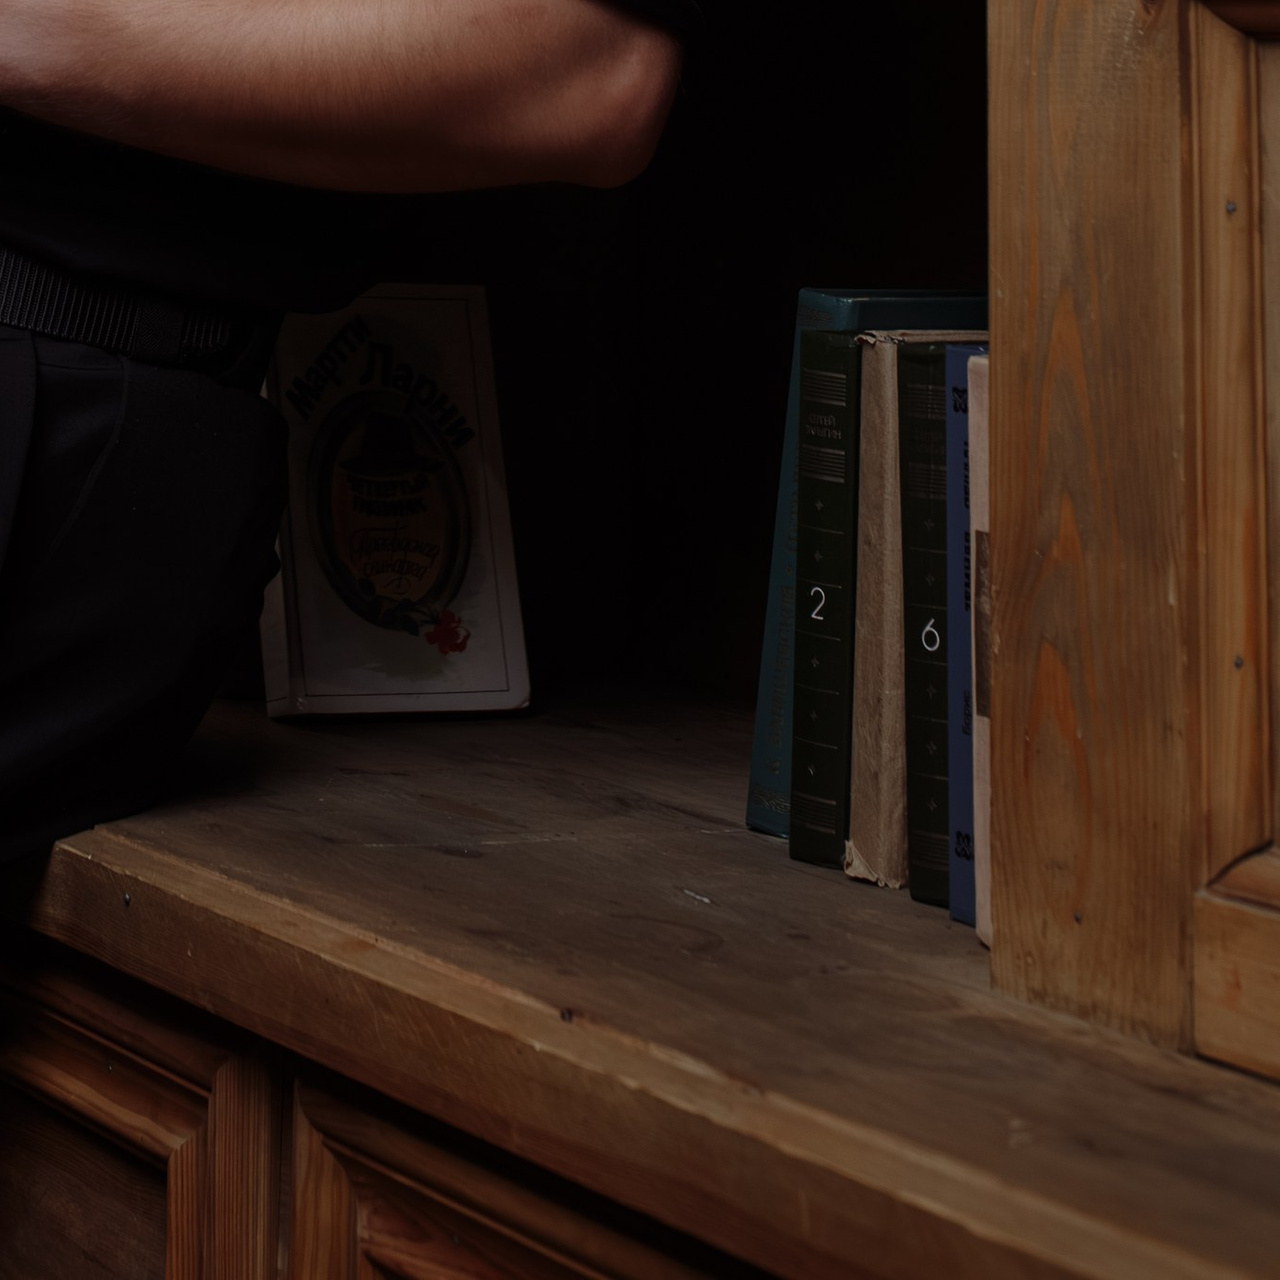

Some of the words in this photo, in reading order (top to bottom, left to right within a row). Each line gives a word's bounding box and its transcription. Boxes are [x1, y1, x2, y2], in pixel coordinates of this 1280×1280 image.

[285, 313, 374, 422] Мартти
[359, 341, 476, 450] Ларни
[809, 586, 825, 622] 2
[920, 618, 941, 652] 6
